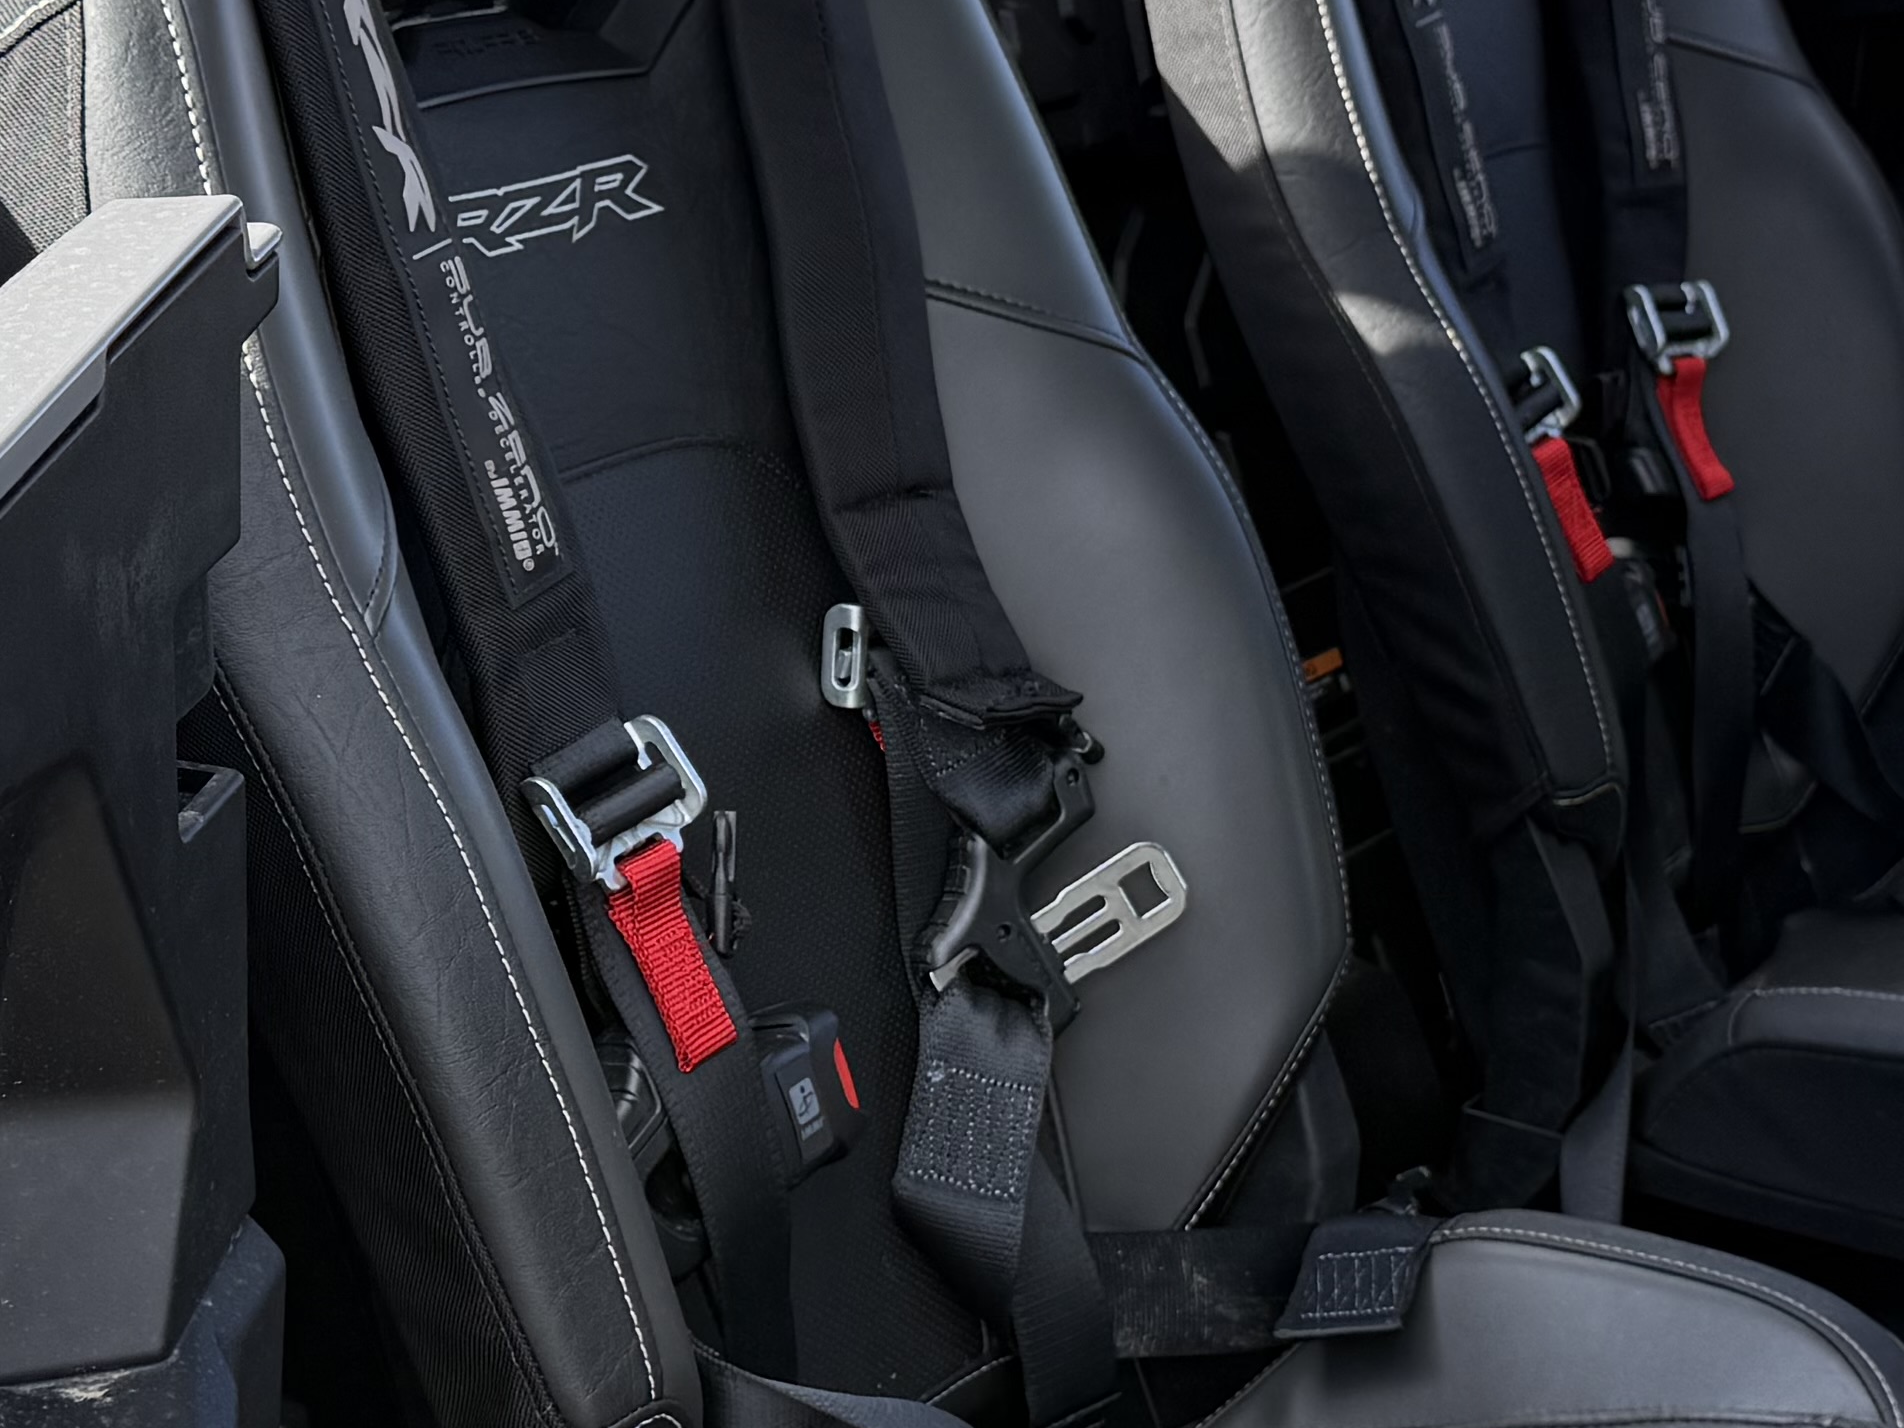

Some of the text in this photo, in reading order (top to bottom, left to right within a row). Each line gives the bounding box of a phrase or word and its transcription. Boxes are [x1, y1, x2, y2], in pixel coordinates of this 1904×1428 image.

[447, 154, 664, 258] RZR
[447, 256, 557, 549] SUB ZERO
[487, 409, 545, 556] DECELERATOR
